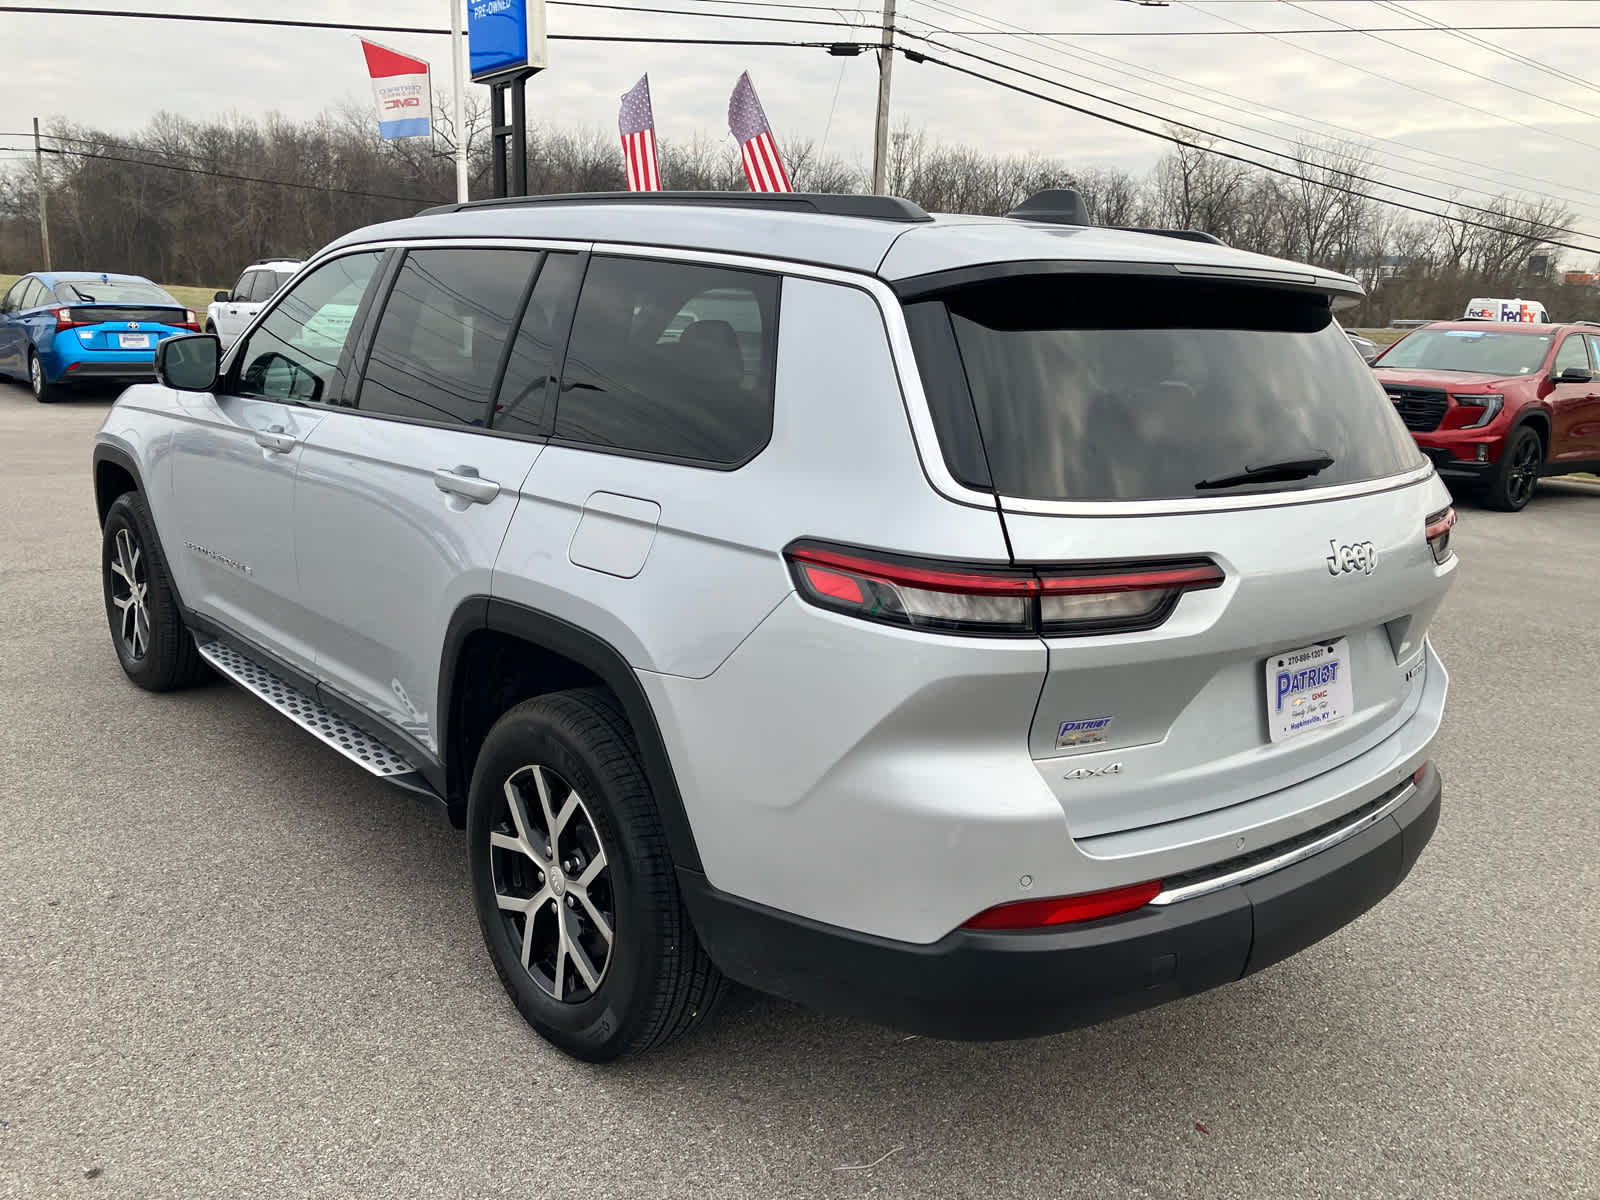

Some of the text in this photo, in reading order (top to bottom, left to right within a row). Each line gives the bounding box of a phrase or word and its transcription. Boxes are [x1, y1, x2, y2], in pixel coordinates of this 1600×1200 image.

[474, 0, 511, 20] PRE-OWNED
[1468, 308, 1494, 318] FedEx
[1501, 304, 1536, 323] FedEx
[1326, 539, 1377, 576] Jeep
[1276, 661, 1339, 710] PATRIOT
[1312, 690, 1328, 701] GMC
[1321, 711, 1330, 720] KY
[1060, 718, 1111, 736] PATRIOT
